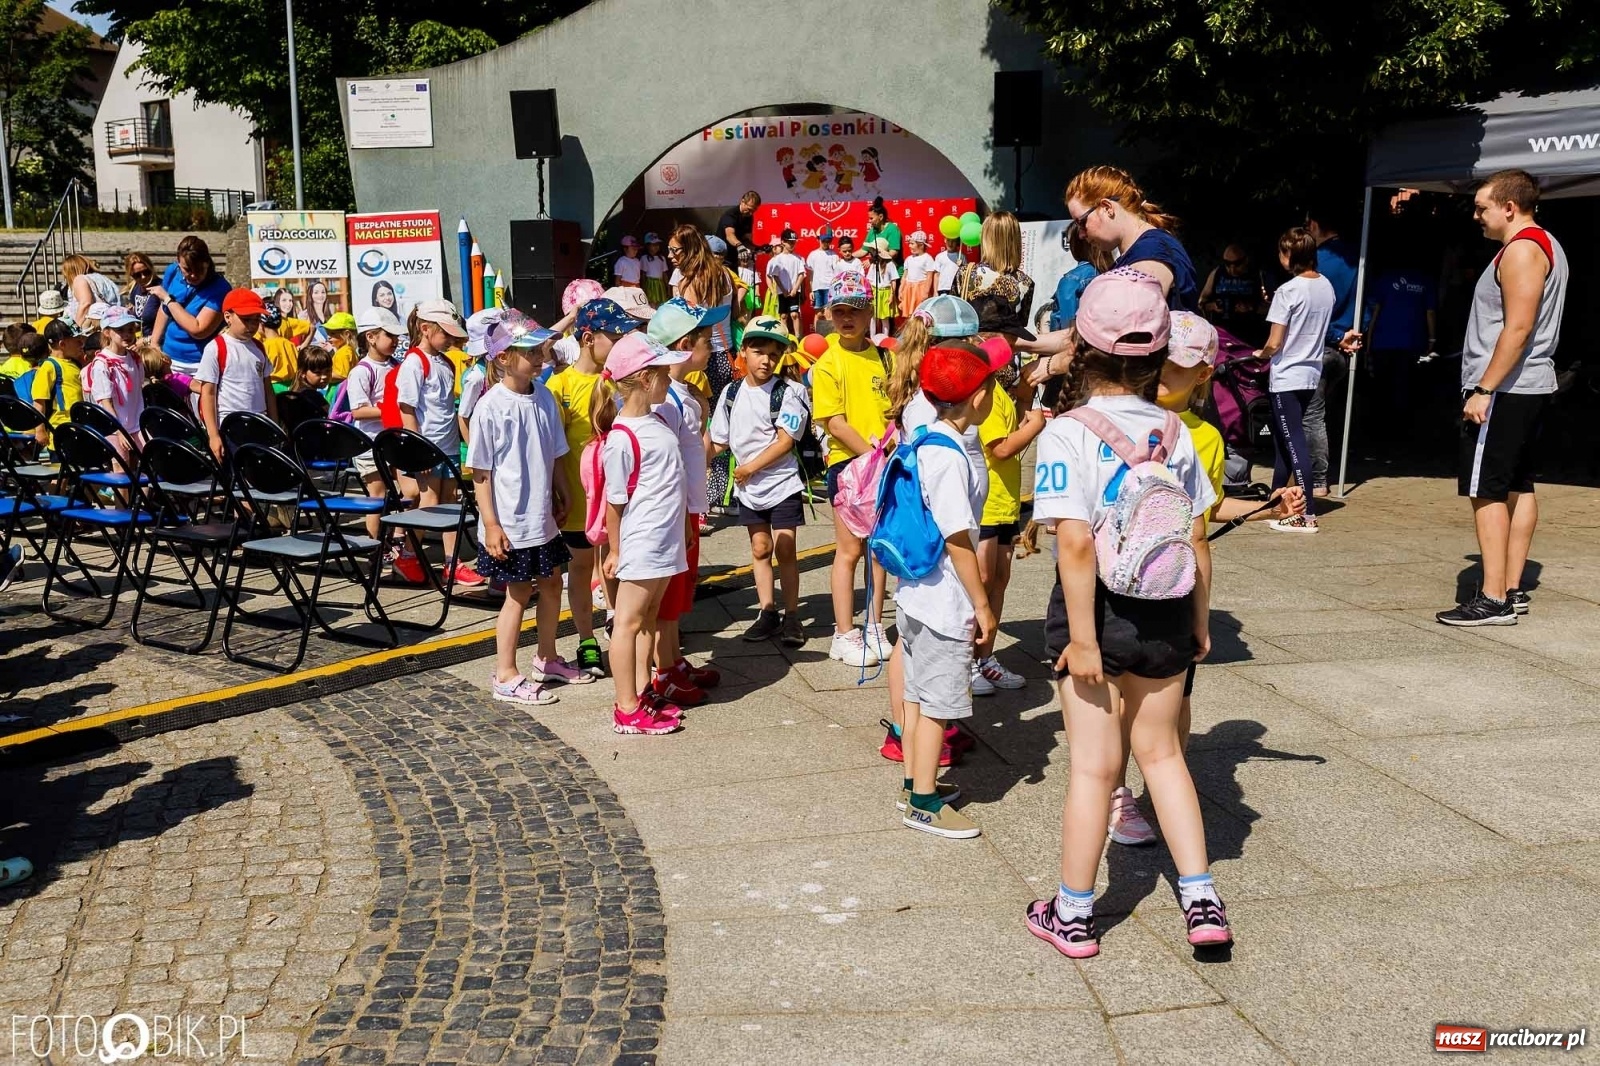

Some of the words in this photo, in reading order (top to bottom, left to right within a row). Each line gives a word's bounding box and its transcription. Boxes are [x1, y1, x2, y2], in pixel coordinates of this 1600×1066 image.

[703, 122, 784, 141] Festiwal
[791, 118, 875, 137] Piosenki
[354, 220, 401, 230] BEZPŁATNE
[402, 219, 433, 227] STUDIA
[260, 229, 336, 240] PEDAGOGIKA
[800, 227, 858, 238] RAÓRZ
[296, 259, 337, 270] PWSZ
[393, 259, 432, 271] PWSZ
[782, 413, 799, 430] 20
[1280, 415, 1291, 438] BEAUTY
[1036, 462, 1068, 493] 20
[910, 810, 932, 824] FILA
